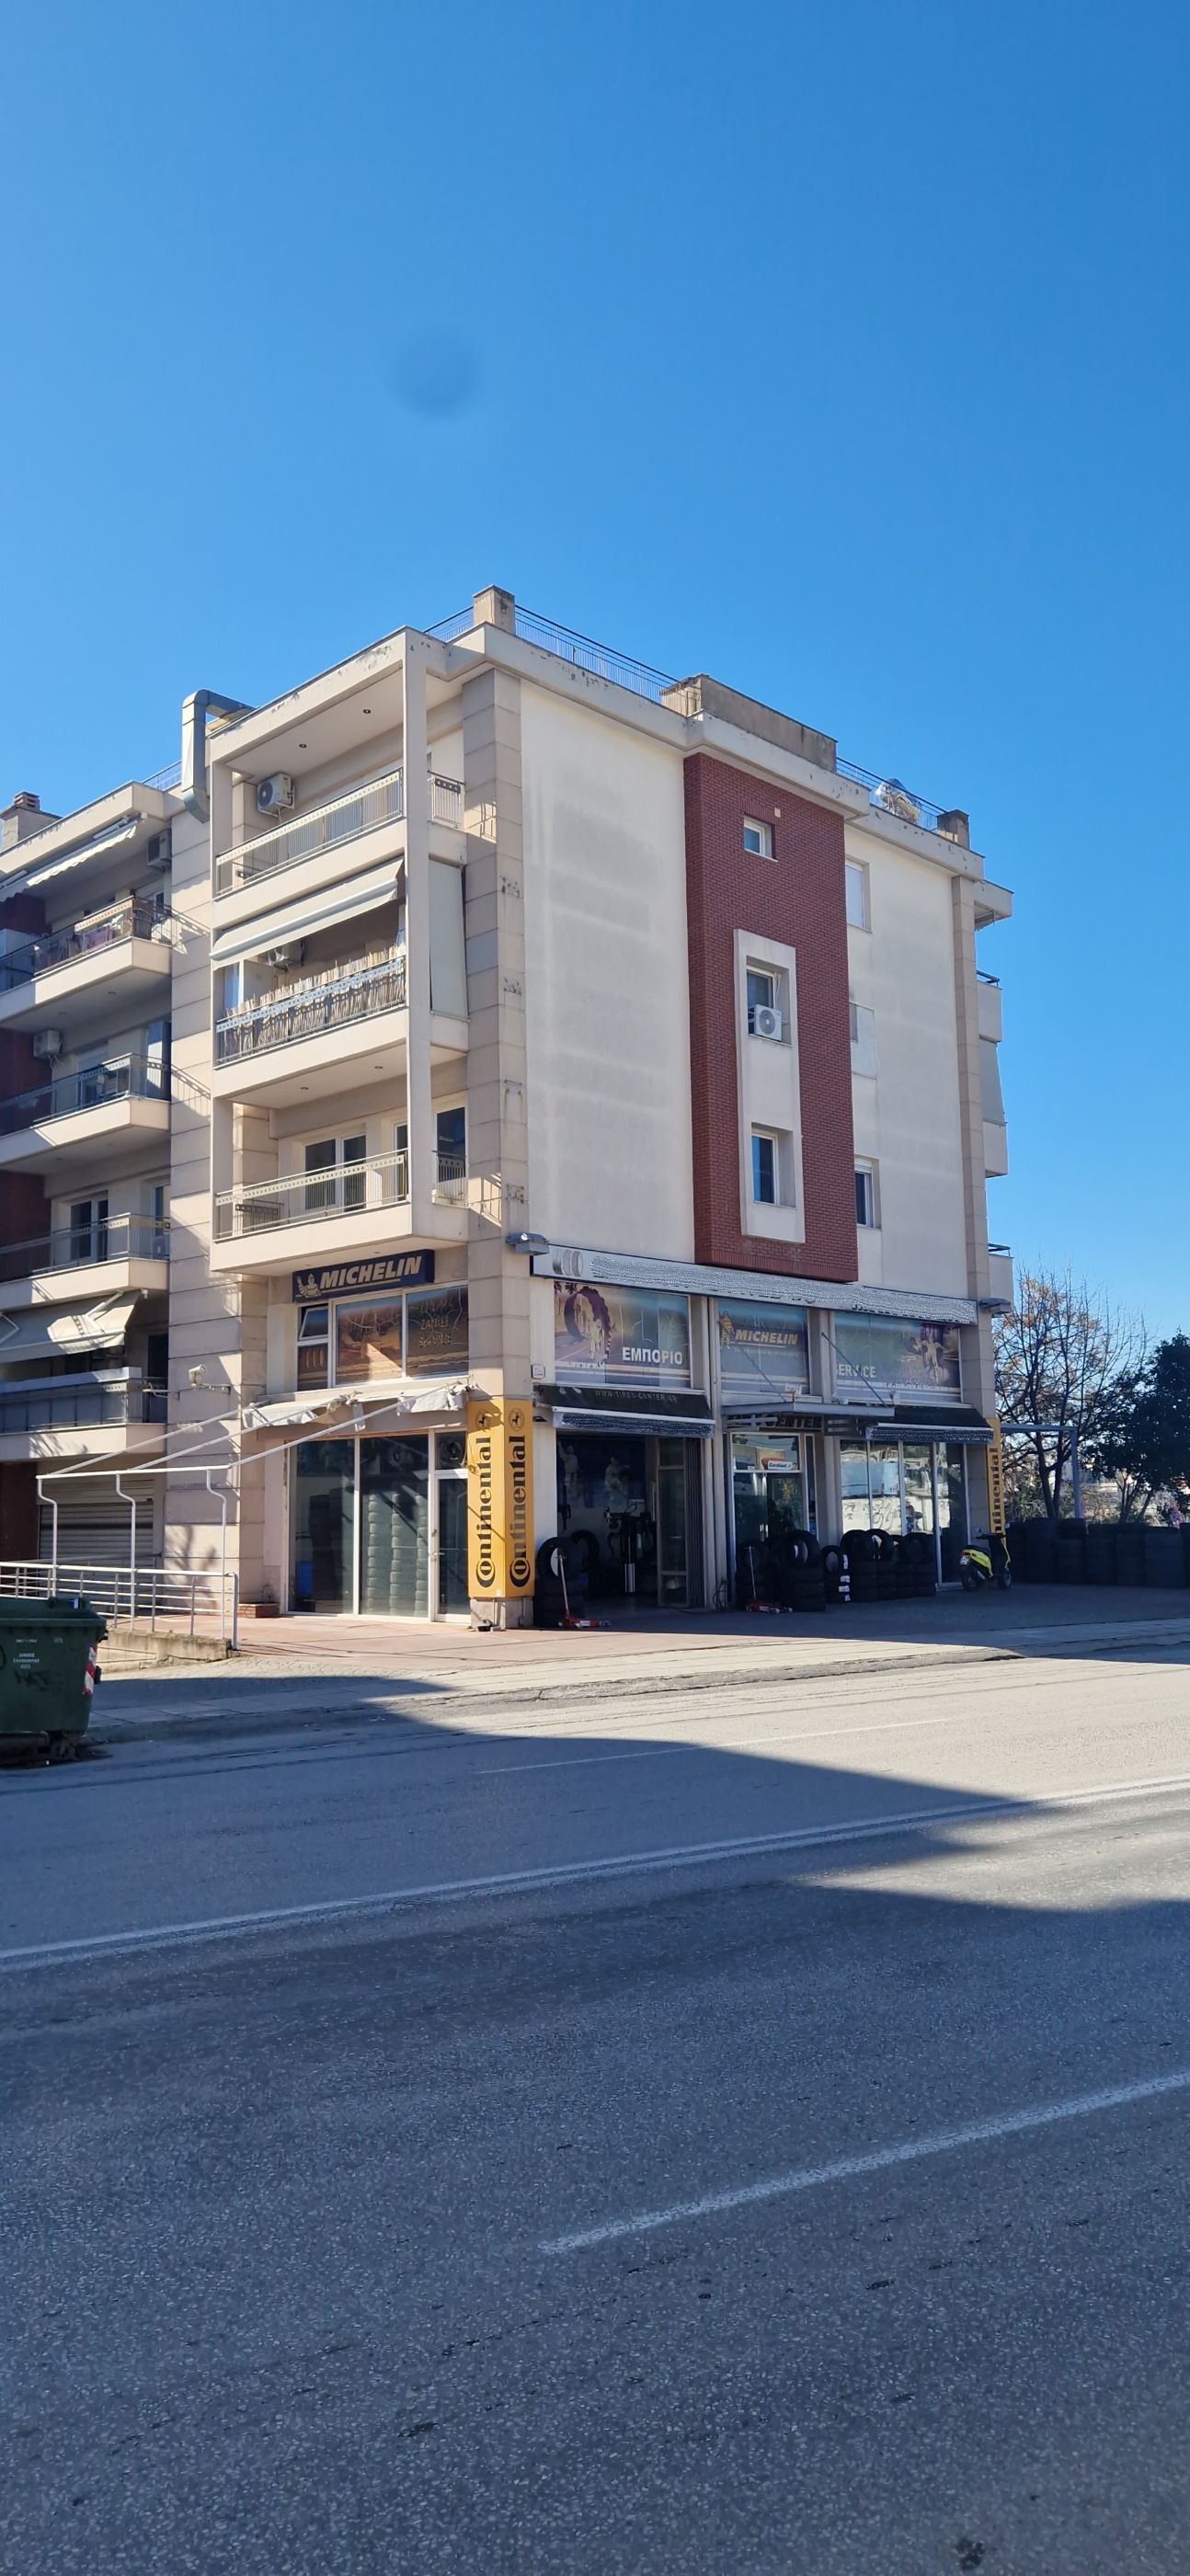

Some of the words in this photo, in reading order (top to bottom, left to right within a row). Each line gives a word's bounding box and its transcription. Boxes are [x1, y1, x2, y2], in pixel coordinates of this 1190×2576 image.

[319, 1255, 422, 1289] MICHELIN
[735, 1329, 798, 1345] MICHELIN
[622, 1346, 683, 1365] ΕΜΠΟΡΙΟ
[475, 1436, 496, 1588] Continental
[509, 1436, 531, 1588] Continental
